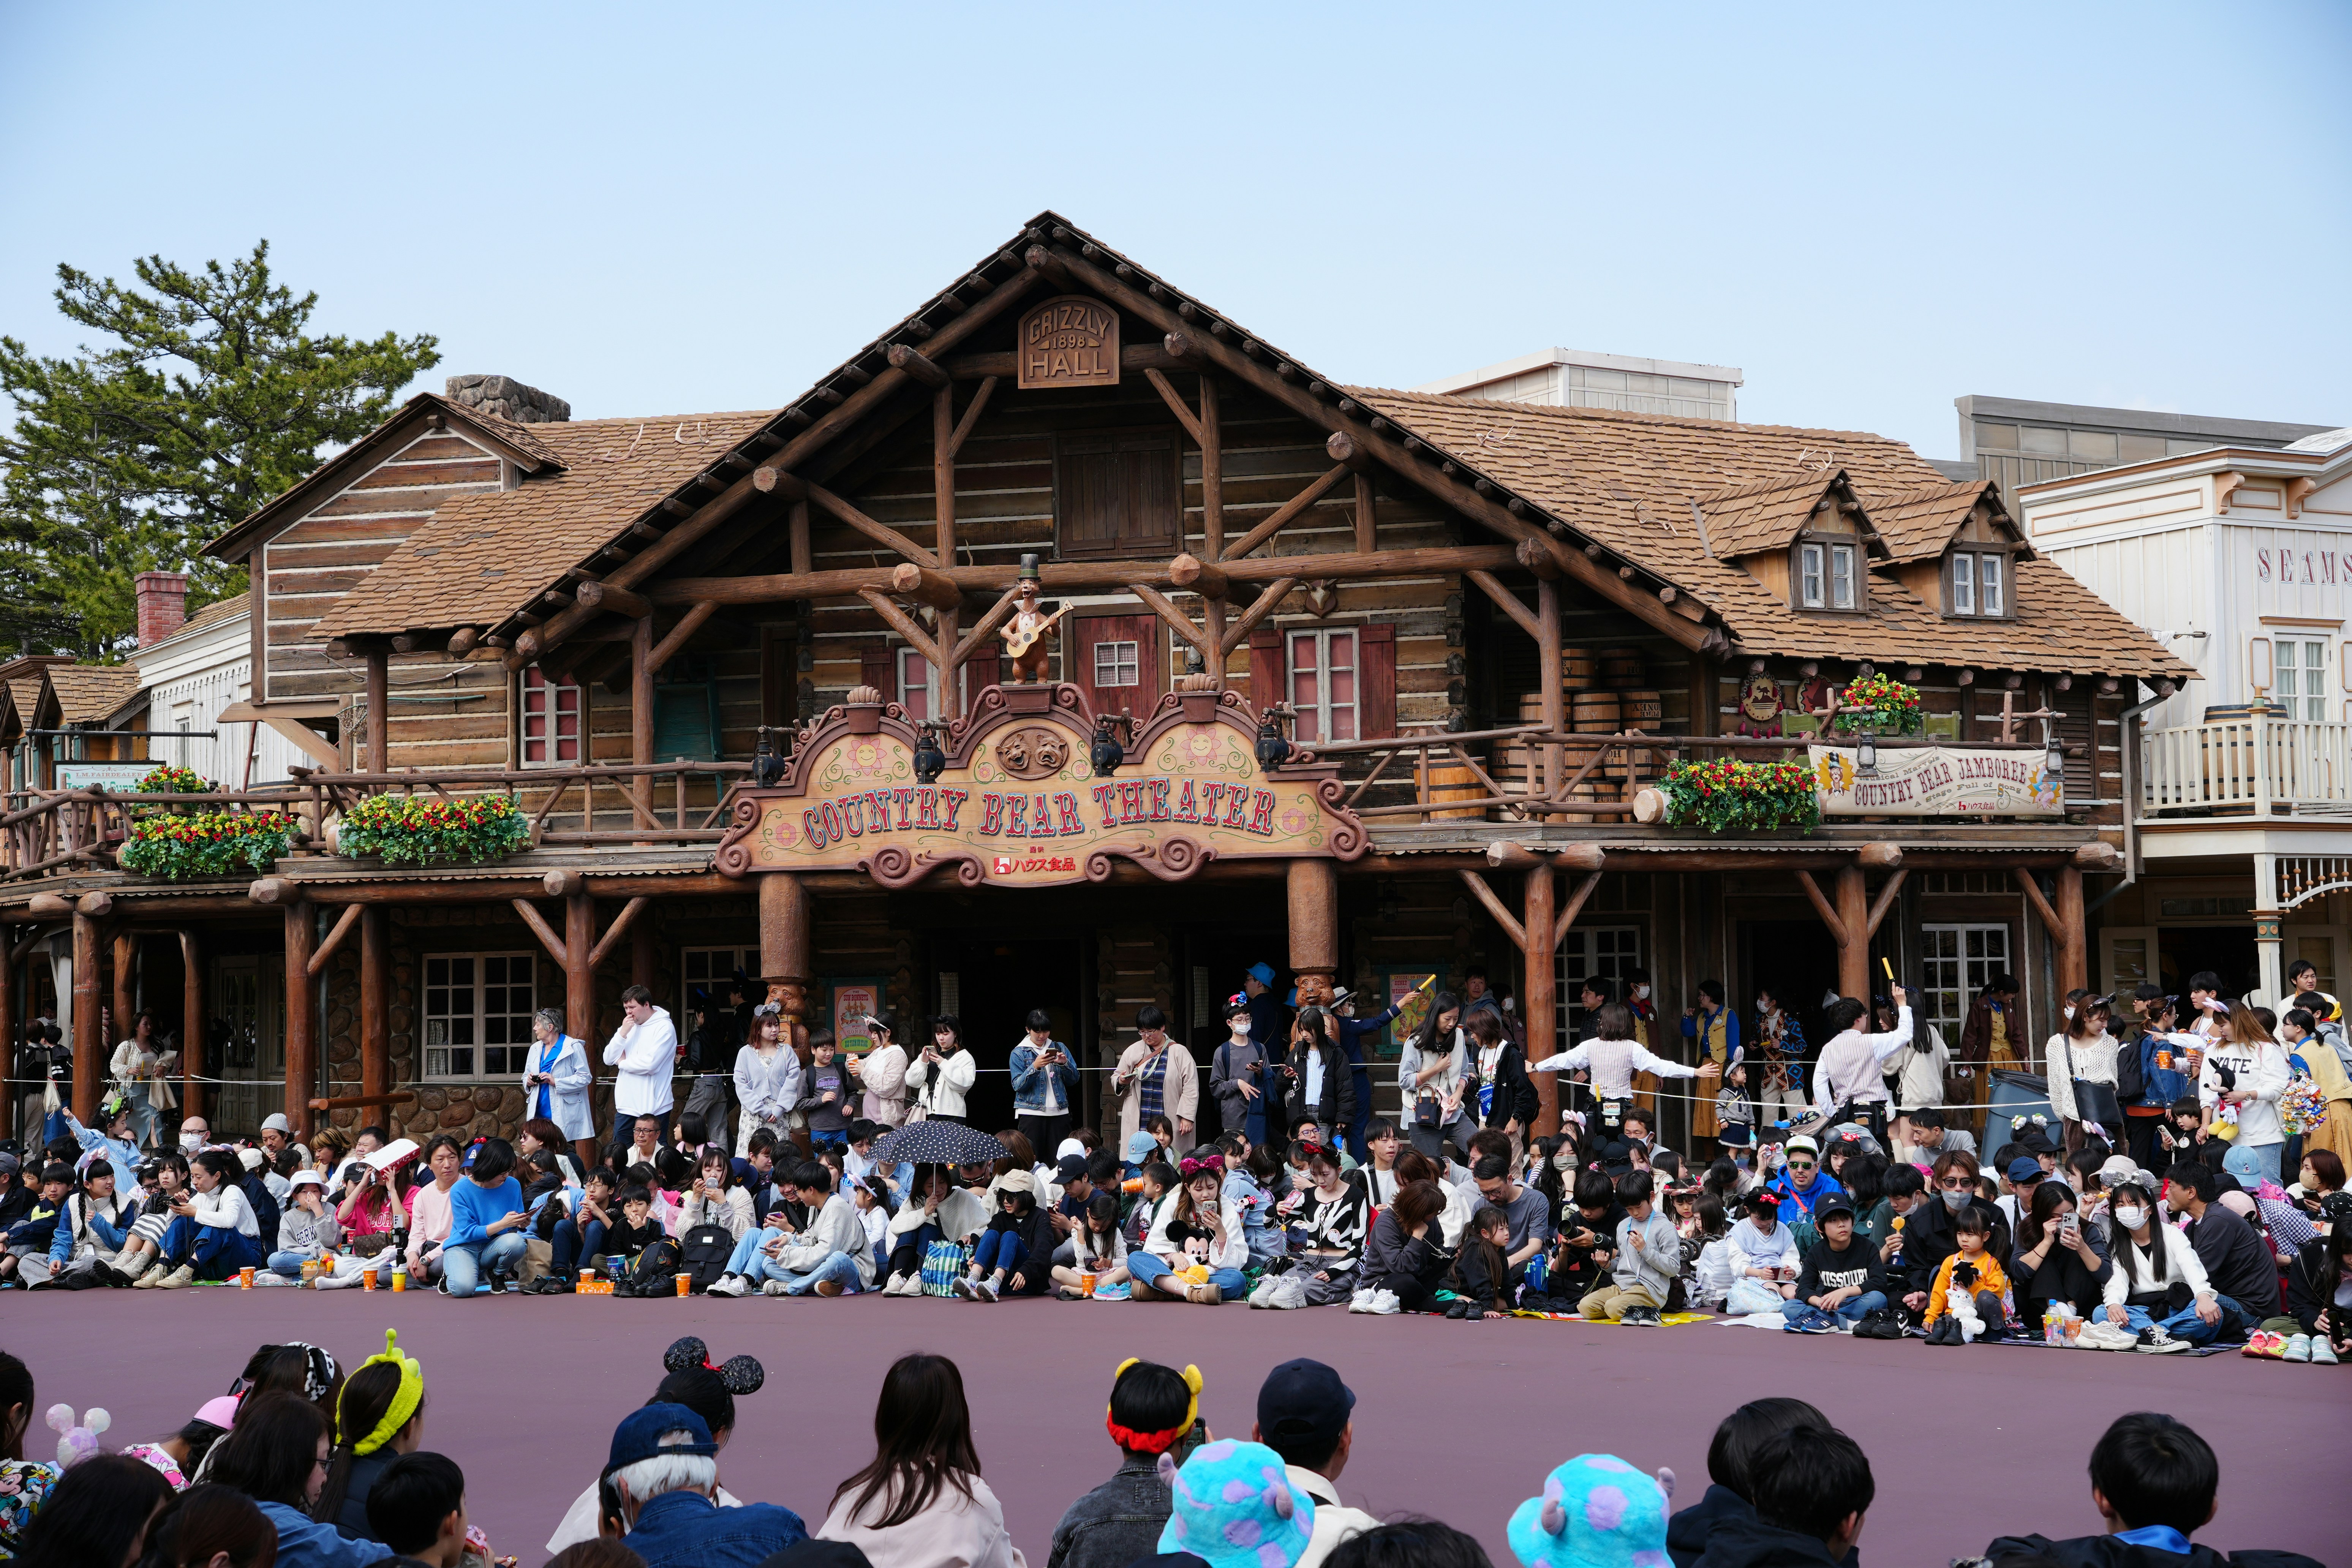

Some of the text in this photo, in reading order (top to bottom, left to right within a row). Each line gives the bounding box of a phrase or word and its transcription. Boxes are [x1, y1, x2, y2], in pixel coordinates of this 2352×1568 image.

[1029, 305, 1110, 344] GRIZZLY
[1053, 334, 1085, 348] 1898
[1029, 350, 1108, 377] HALL
[1903, 756, 1940, 775] Marvels
[1855, 756, 2027, 807] COUNTRY BEAR JAMBOREE
[1925, 789, 1952, 802] Stage
[1997, 783, 2022, 797] Song
[802, 777, 1275, 849] COUNTRY BEAR THEATER
[1012, 857, 1075, 873] ハウス食品
[468, 1149, 477, 1159] A
[296, 1225, 316, 1245] BERK
[1818, 1268, 1868, 1288] MISSOURI
